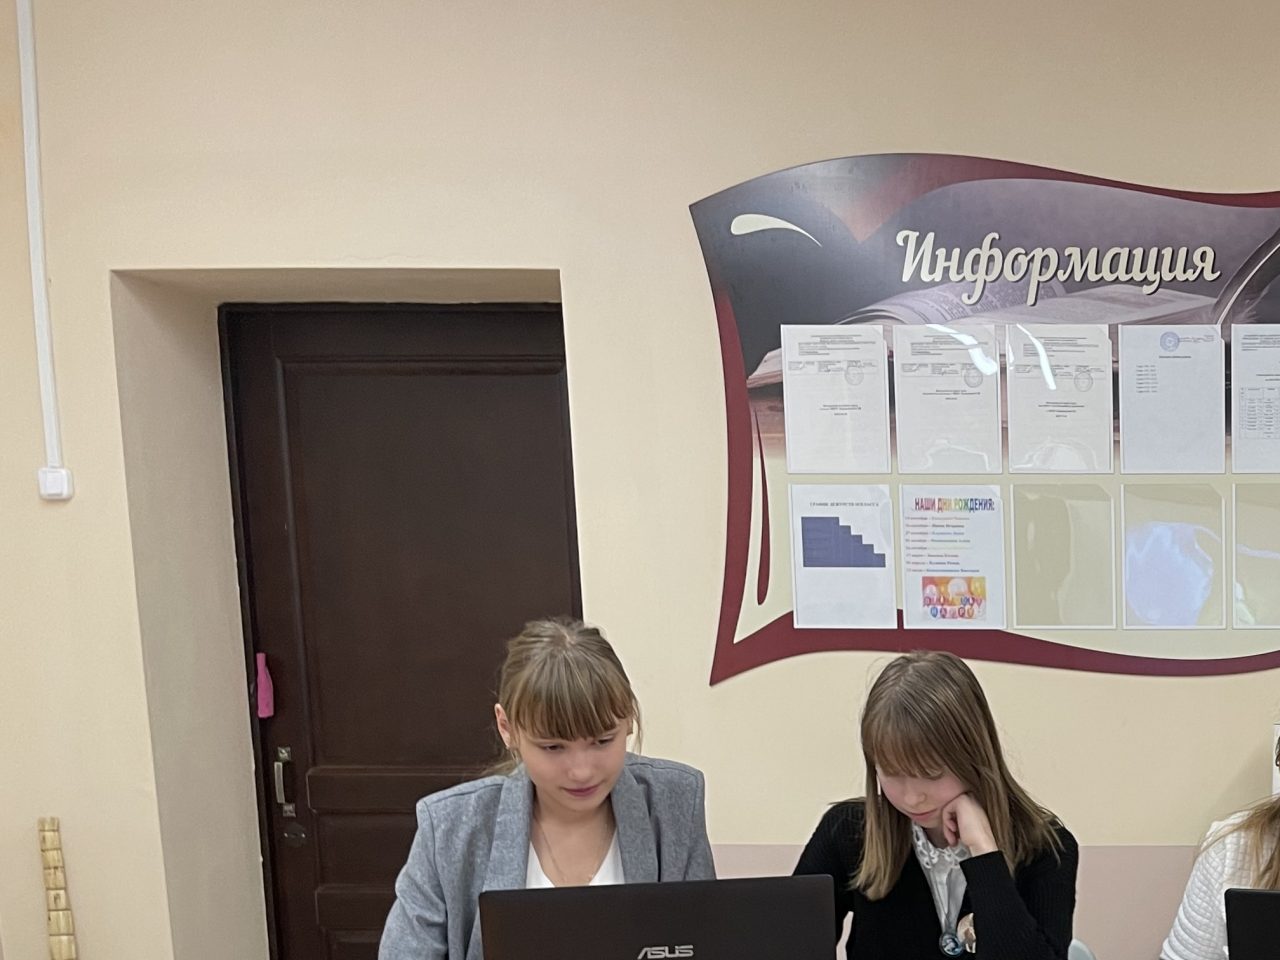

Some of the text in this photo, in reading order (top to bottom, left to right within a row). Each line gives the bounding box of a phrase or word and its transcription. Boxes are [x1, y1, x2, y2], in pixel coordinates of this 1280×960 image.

[895, 229, 1221, 306] Информация
[914, 498, 936, 511] НАШИ
[637, 945, 694, 960] ASUS
